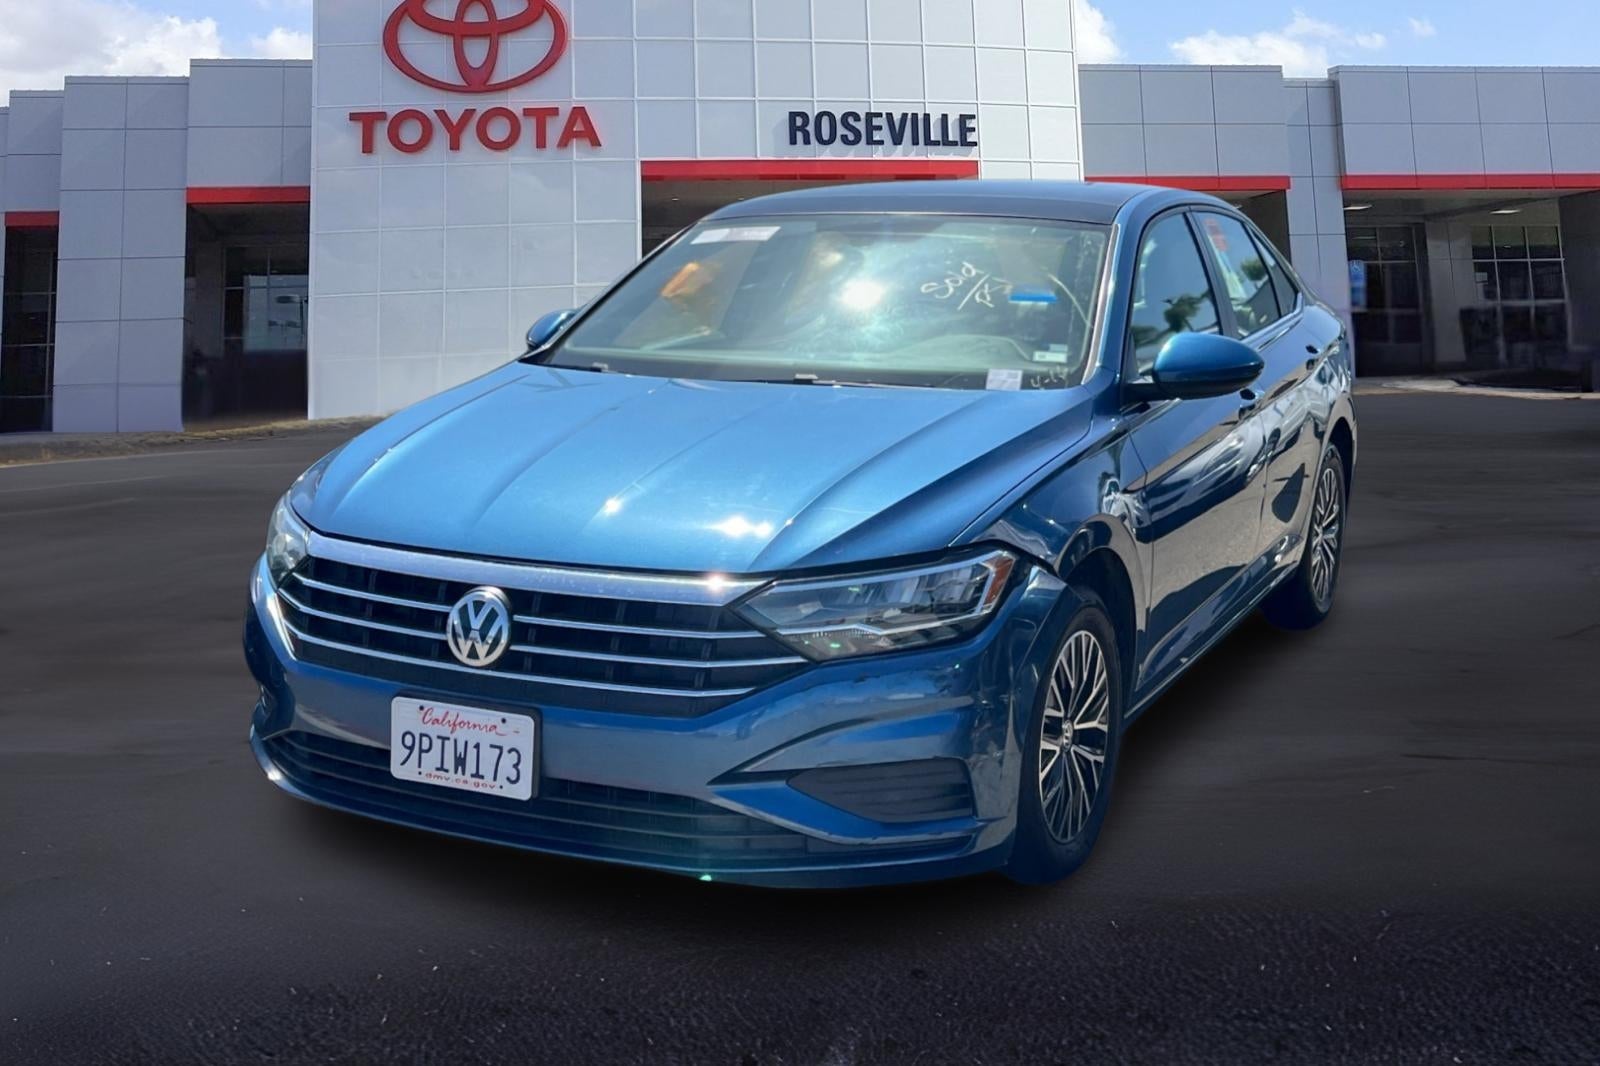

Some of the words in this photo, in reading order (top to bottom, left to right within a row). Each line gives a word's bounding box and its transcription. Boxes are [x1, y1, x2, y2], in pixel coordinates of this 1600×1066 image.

[349, 106, 602, 154] TOYOTA
[789, 111, 979, 147] ROSEVILLE
[448, 591, 509, 667] VW
[421, 707, 507, 736] California
[400, 731, 522, 784] 9PIW173
[425, 772, 496, 789] dmv.ca.gov
